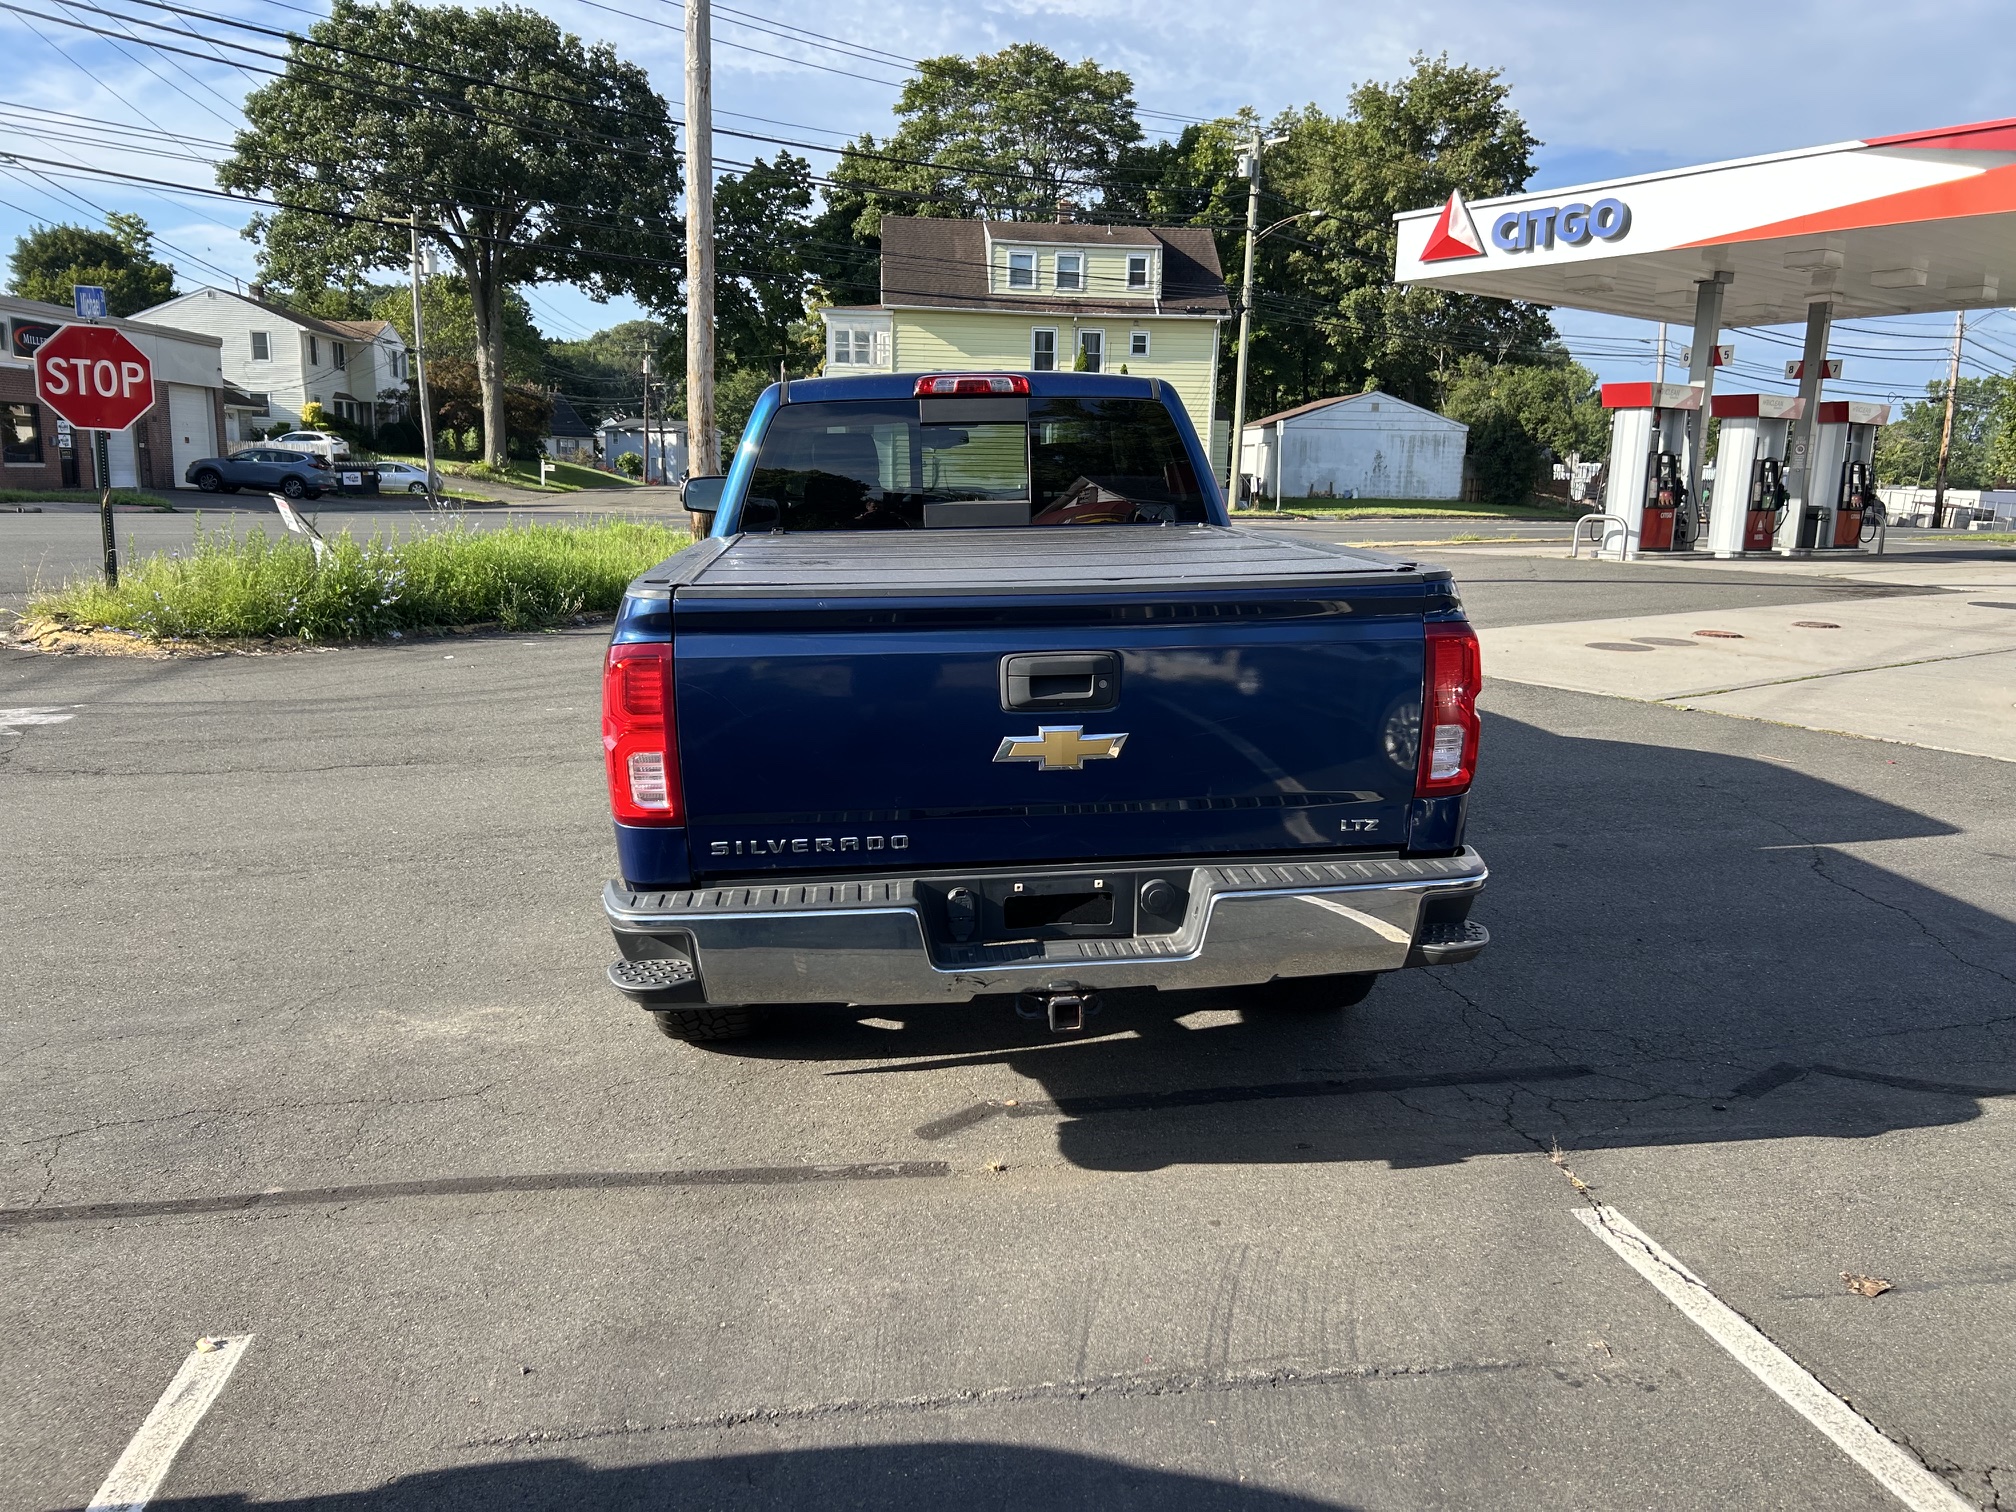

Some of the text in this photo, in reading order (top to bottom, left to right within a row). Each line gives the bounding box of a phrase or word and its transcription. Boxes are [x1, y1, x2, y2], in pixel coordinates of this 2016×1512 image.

[1491, 198, 1629, 251] CITGO
[80, 292, 101, 317] Michael
[1683, 353, 1689, 361] 6
[1724, 350, 1730, 360] 5
[1788, 365, 1794, 374] 8
[1833, 364, 1839, 373] 7
[45, 356, 145, 398] STOP
[1340, 818, 1380, 832] LTZ
[710, 834, 909, 856] SILVERADO
